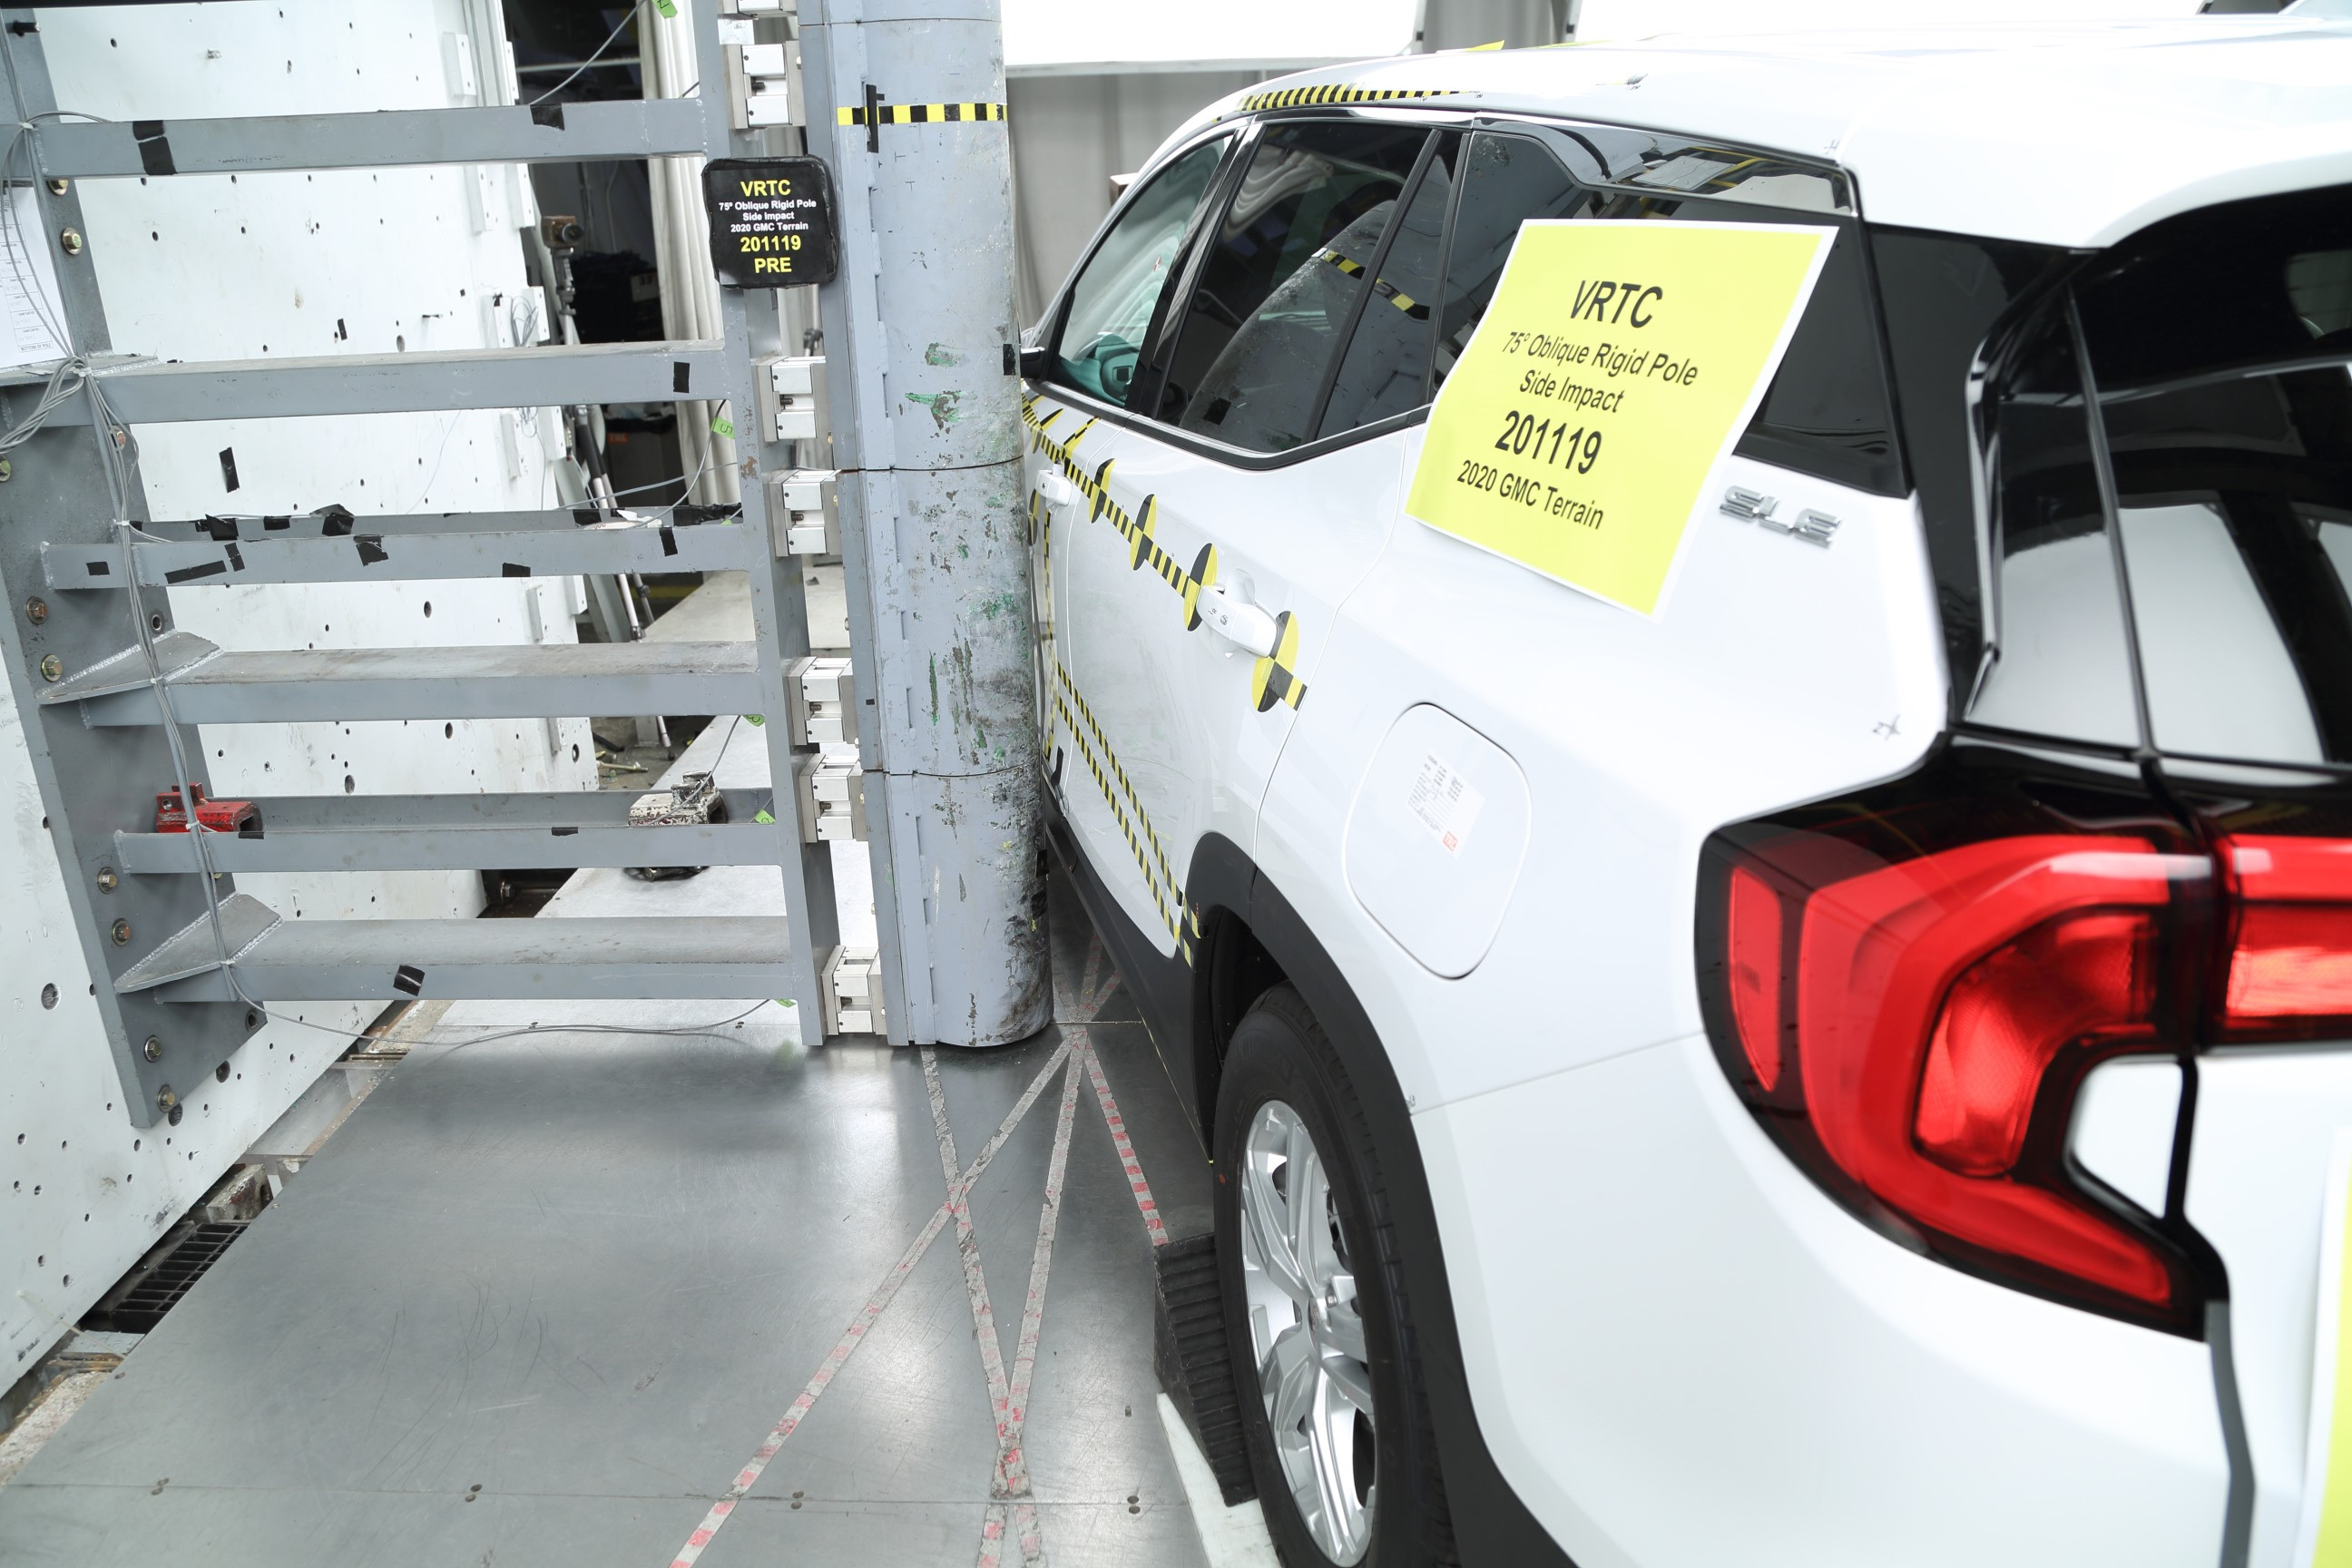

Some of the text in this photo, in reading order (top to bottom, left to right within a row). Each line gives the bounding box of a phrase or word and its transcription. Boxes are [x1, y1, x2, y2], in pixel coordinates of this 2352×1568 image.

[740, 180, 791, 197] VRTC
[734, 201, 769, 212] Oblique
[770, 200, 795, 211] Rigid
[797, 199, 817, 209] Pole
[742, 211, 795, 221] Side Impact
[730, 221, 808, 232] 2020 GMC Terrain
[740, 235, 801, 252] 201119
[754, 257, 792, 273] PRE
[1571, 280, 1662, 328] VRTC
[1528, 335, 1589, 367] Oblique
[1592, 343, 1650, 377] Rigid
[1648, 354, 1698, 386] Pole
[1520, 370, 1624, 413] Side Impact
[1495, 411, 1602, 474] 201119
[1457, 460, 1603, 529] 2020 GMC Terrain
[1720, 485, 1842, 548] SLE
